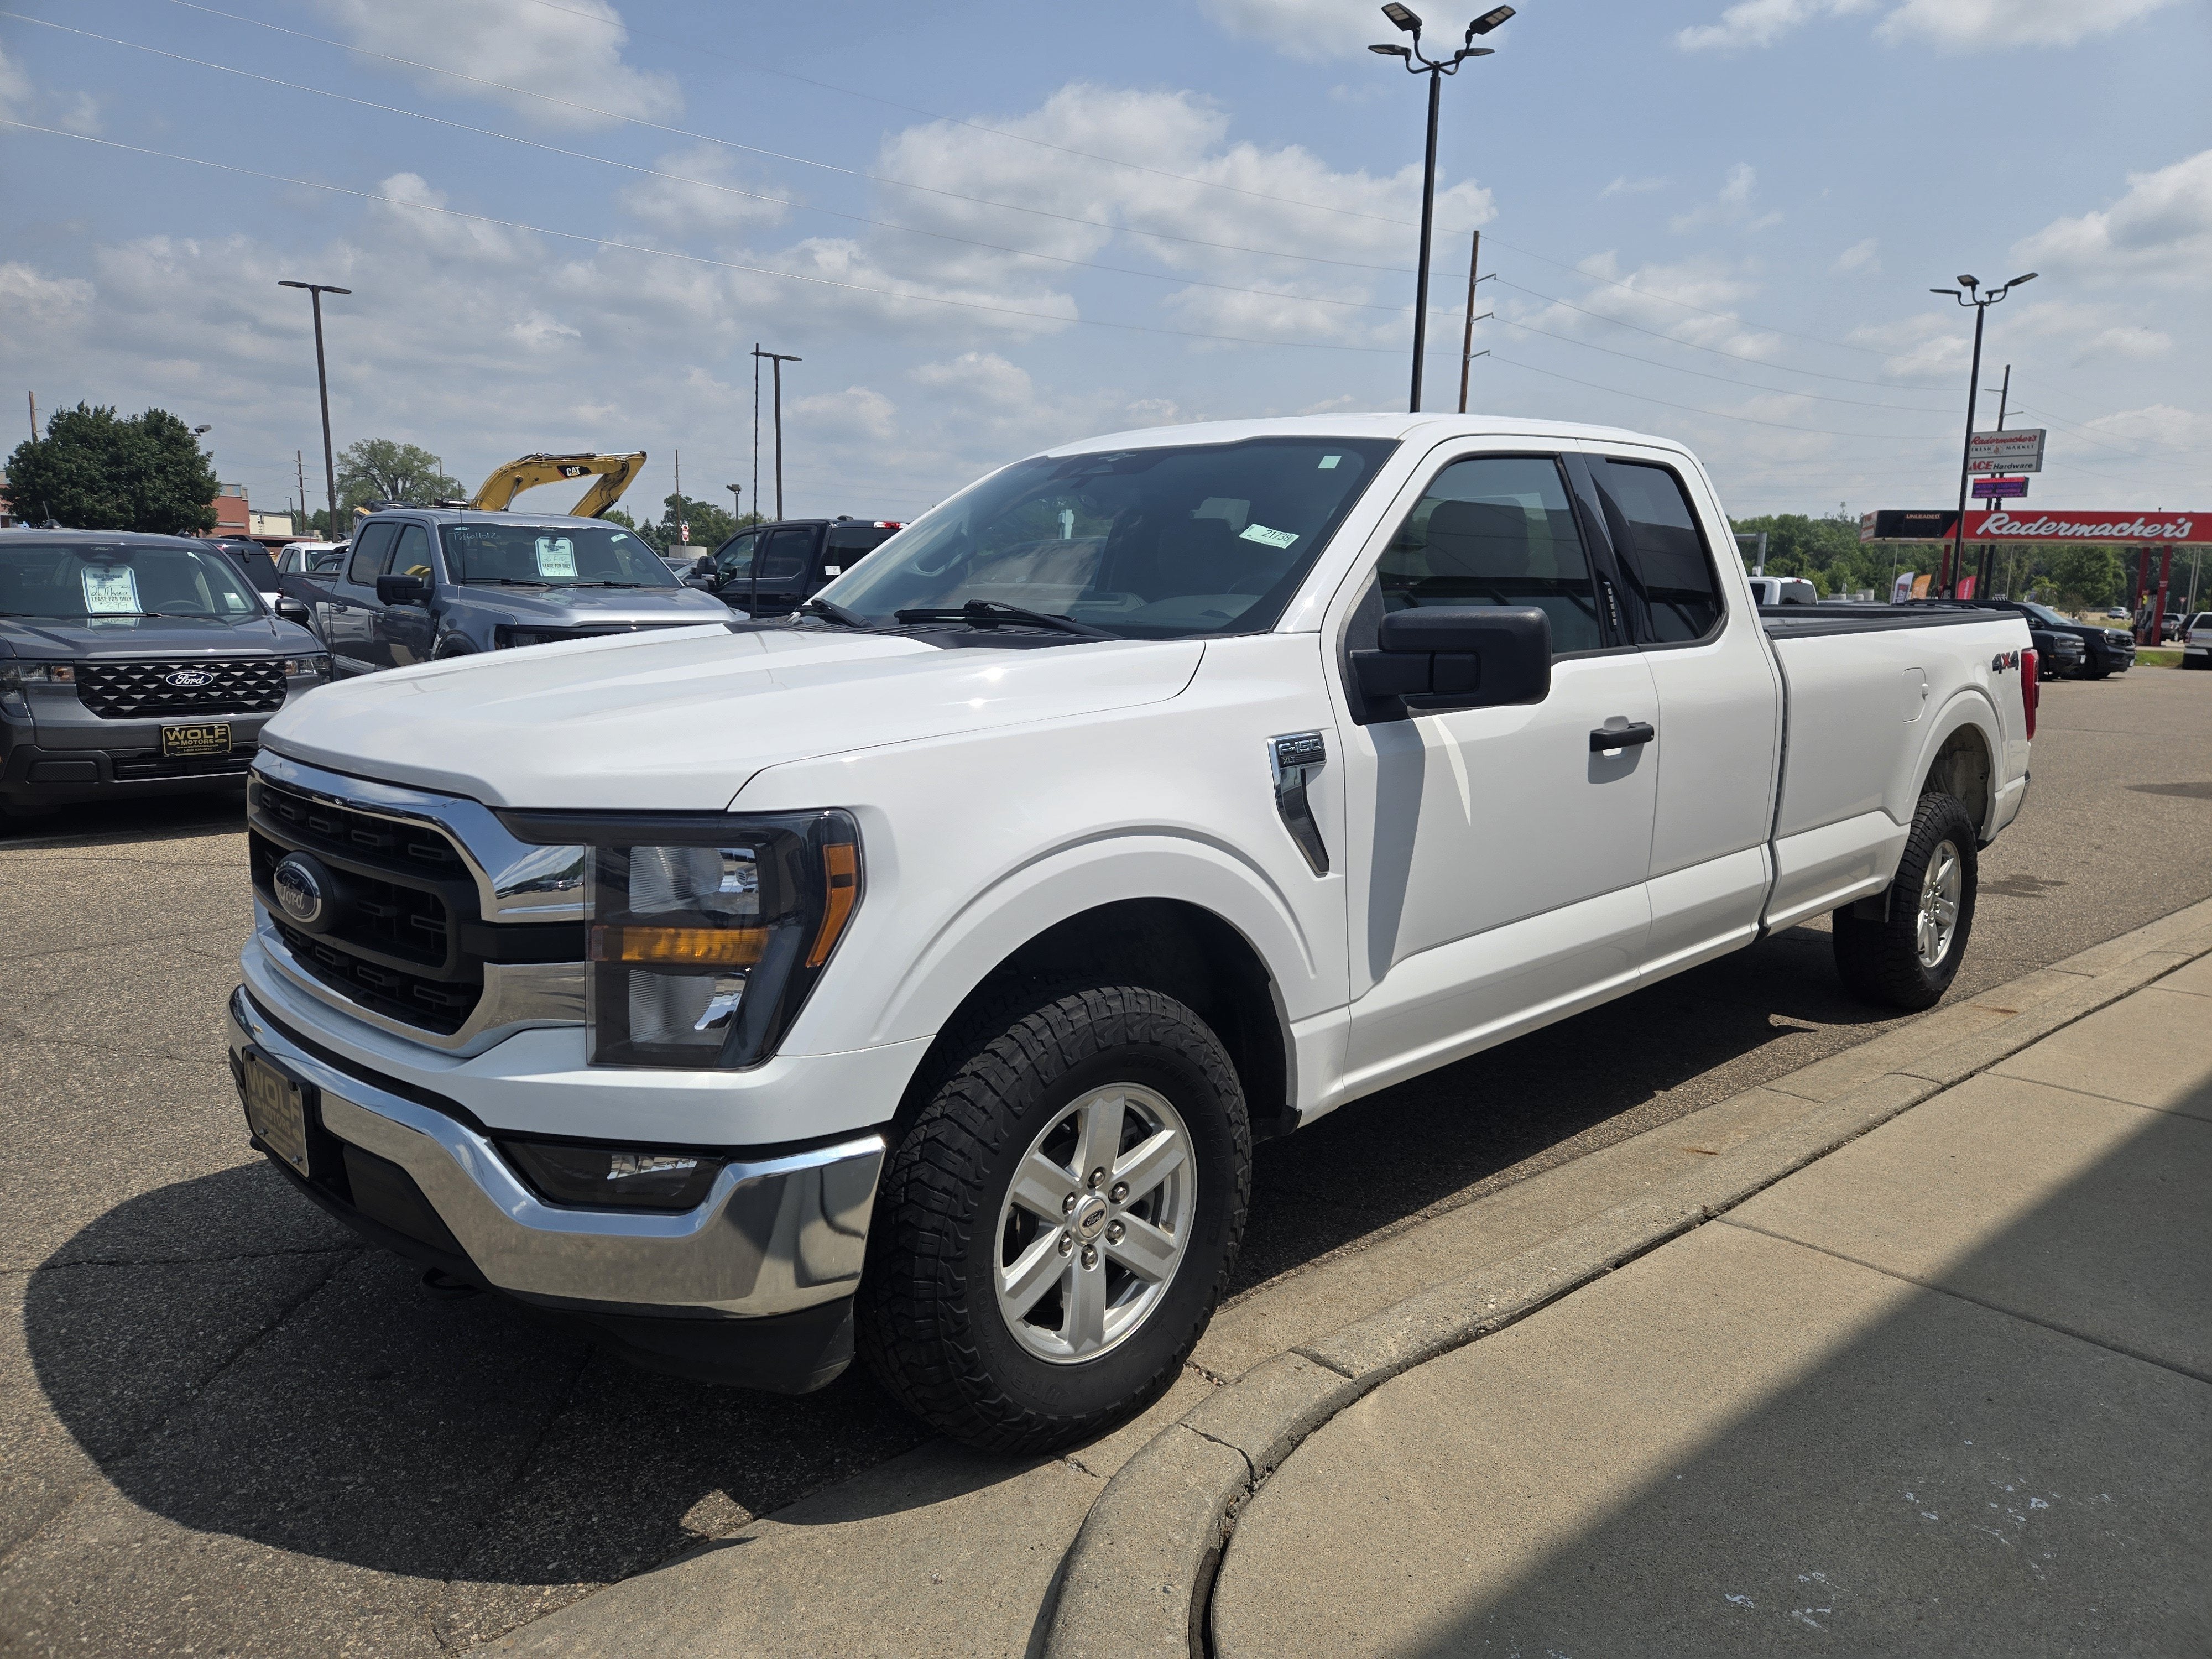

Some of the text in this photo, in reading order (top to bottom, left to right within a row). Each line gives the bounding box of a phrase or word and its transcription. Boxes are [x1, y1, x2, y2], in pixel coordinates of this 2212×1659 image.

[1971, 434, 2037, 445] Radermacher's
[566, 466, 580, 477] CAT
[1968, 460, 1994, 471] ACE
[1976, 513, 2193, 538] Radermacher's
[1261, 530, 1293, 541] 21738
[1992, 650, 2020, 674] 4x4
[175, 673, 205, 685] Ford
[166, 728, 226, 740] WOLF
[1278, 738, 1322, 756] F-150
[1281, 756, 1296, 764] XLT
[279, 873, 305, 910] Ford
[247, 1062, 300, 1123] WOLF
[262, 1102, 292, 1135] MOTORS
[1086, 1212, 1102, 1227] Ford
